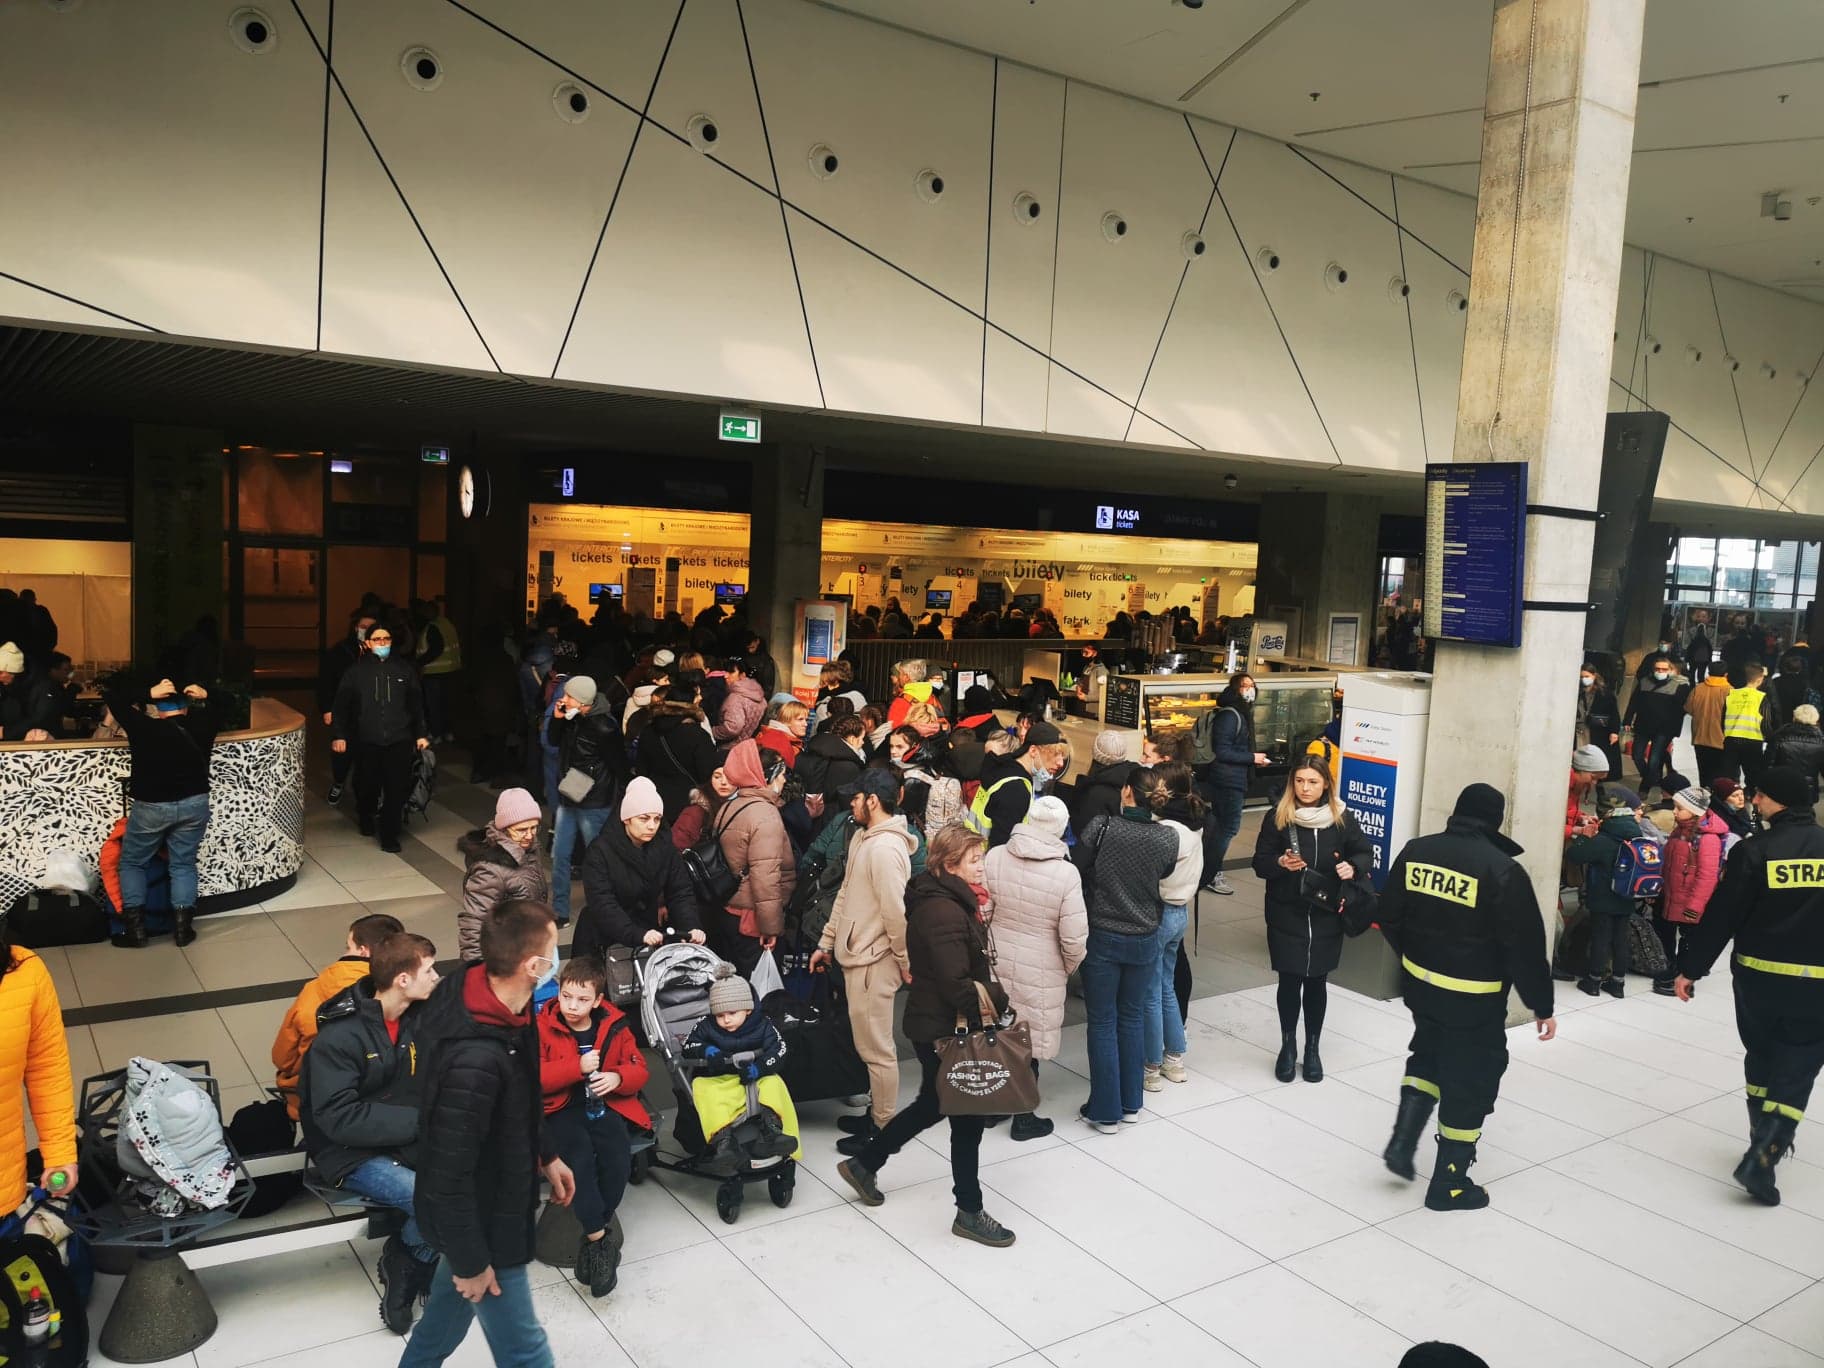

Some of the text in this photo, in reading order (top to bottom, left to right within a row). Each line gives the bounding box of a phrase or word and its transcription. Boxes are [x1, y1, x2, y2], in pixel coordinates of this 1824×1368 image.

[1116, 510, 1139, 520] KASA
[572, 552, 613, 564] tickets
[621, 554, 661, 565] tikets
[685, 578, 716, 591] bilety
[1064, 589, 1092, 600] bilety
[1348, 780, 1387, 798] BILETY
[1347, 792, 1386, 808] KOLEJOWE
[1360, 823, 1385, 838] KETS
[1776, 864, 1824, 884] STRA
[985, 1070, 1010, 1080] BAGS
